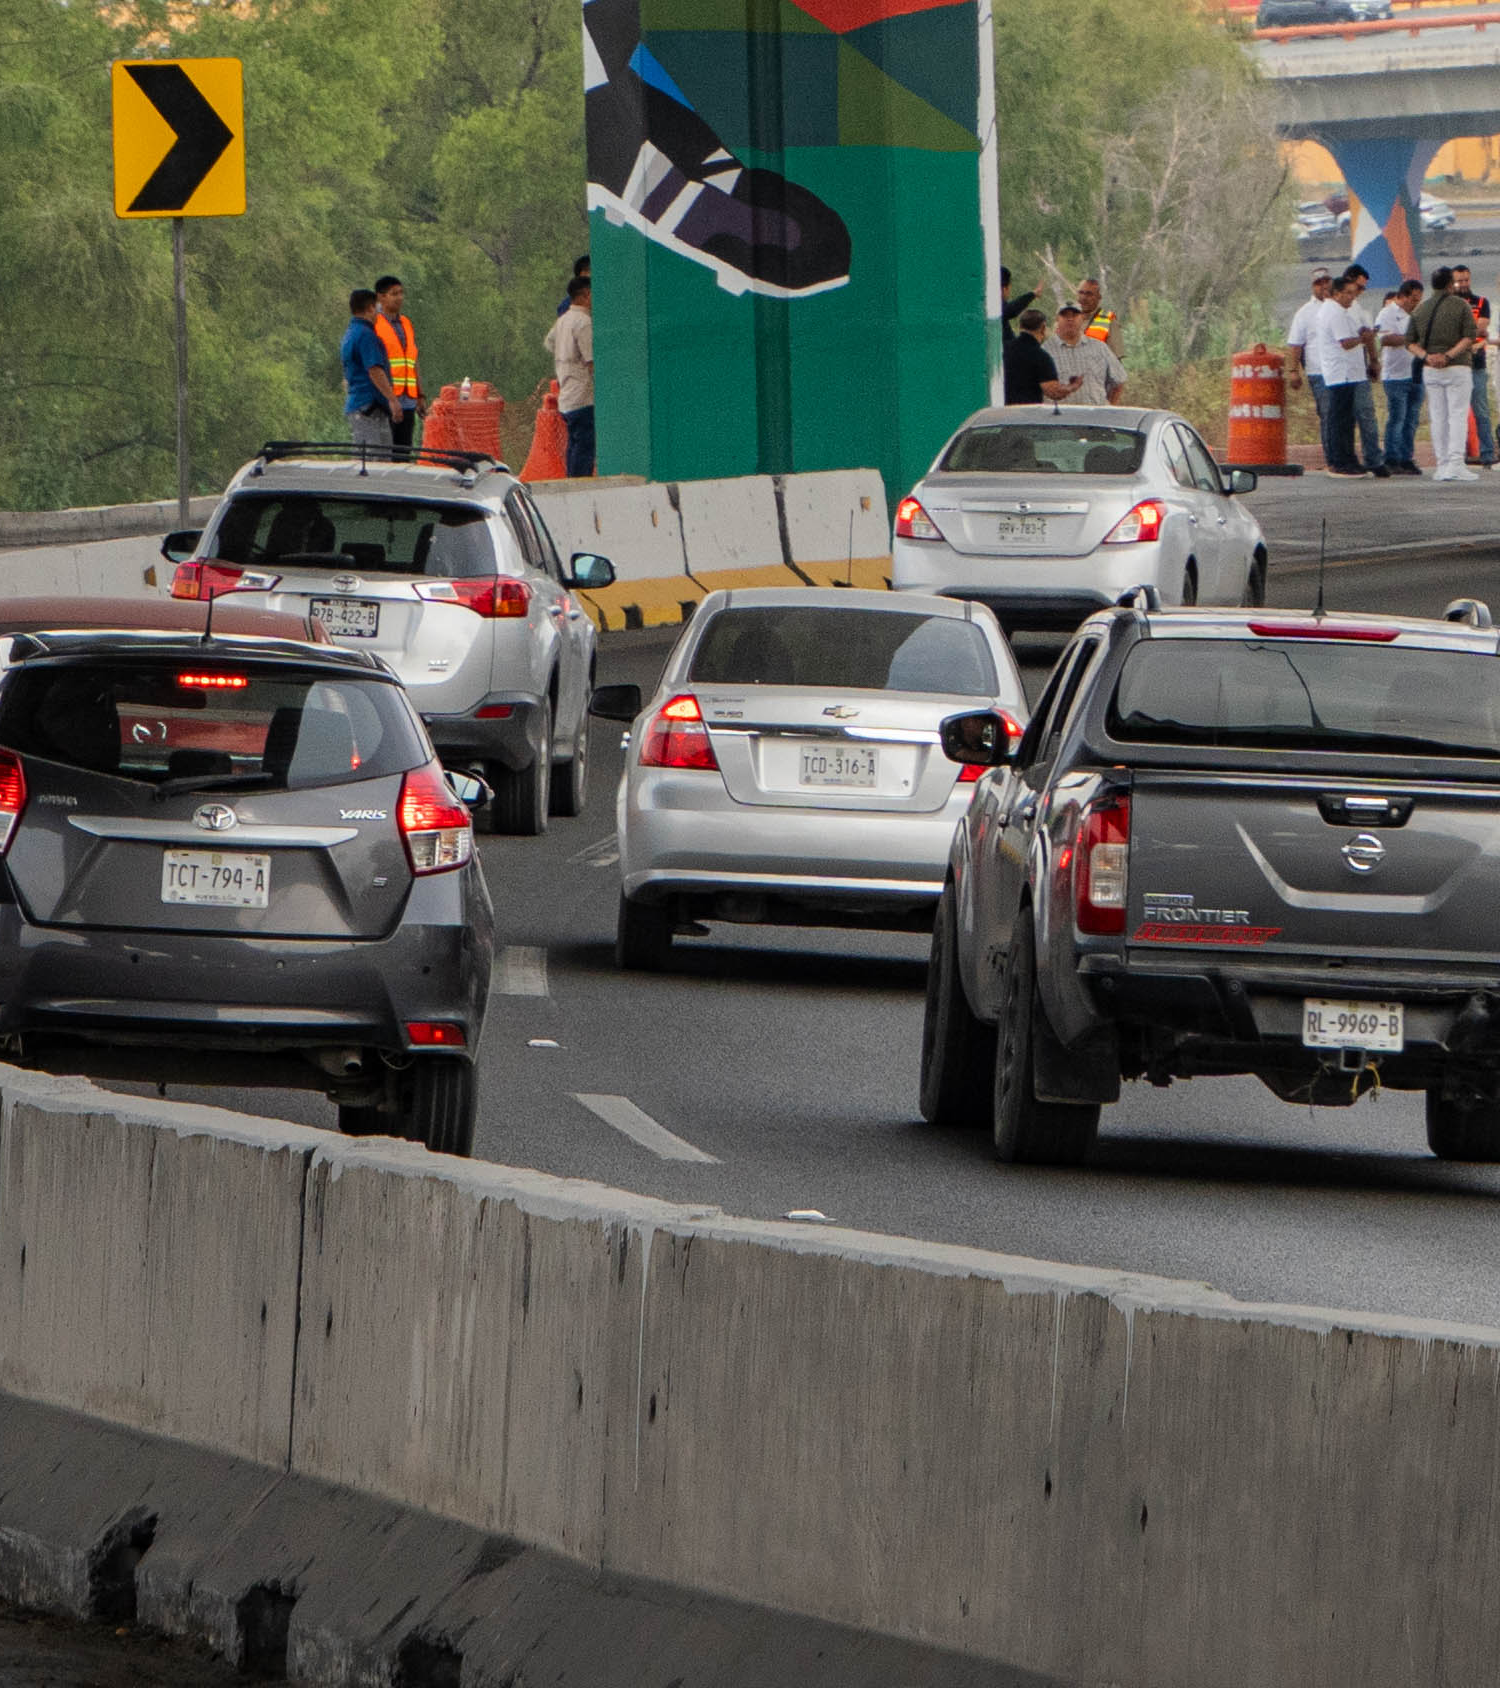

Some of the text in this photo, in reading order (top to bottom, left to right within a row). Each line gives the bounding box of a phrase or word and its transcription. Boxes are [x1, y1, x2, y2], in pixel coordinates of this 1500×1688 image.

[803, 755, 876, 776] TCD-316-A
[340, 808, 388, 820] YARIS
[167, 863, 265, 892] TCT-794-A
[1143, 906, 1250, 925] FRONTIER
[1307, 1011, 1399, 1036] RL-9969-B
